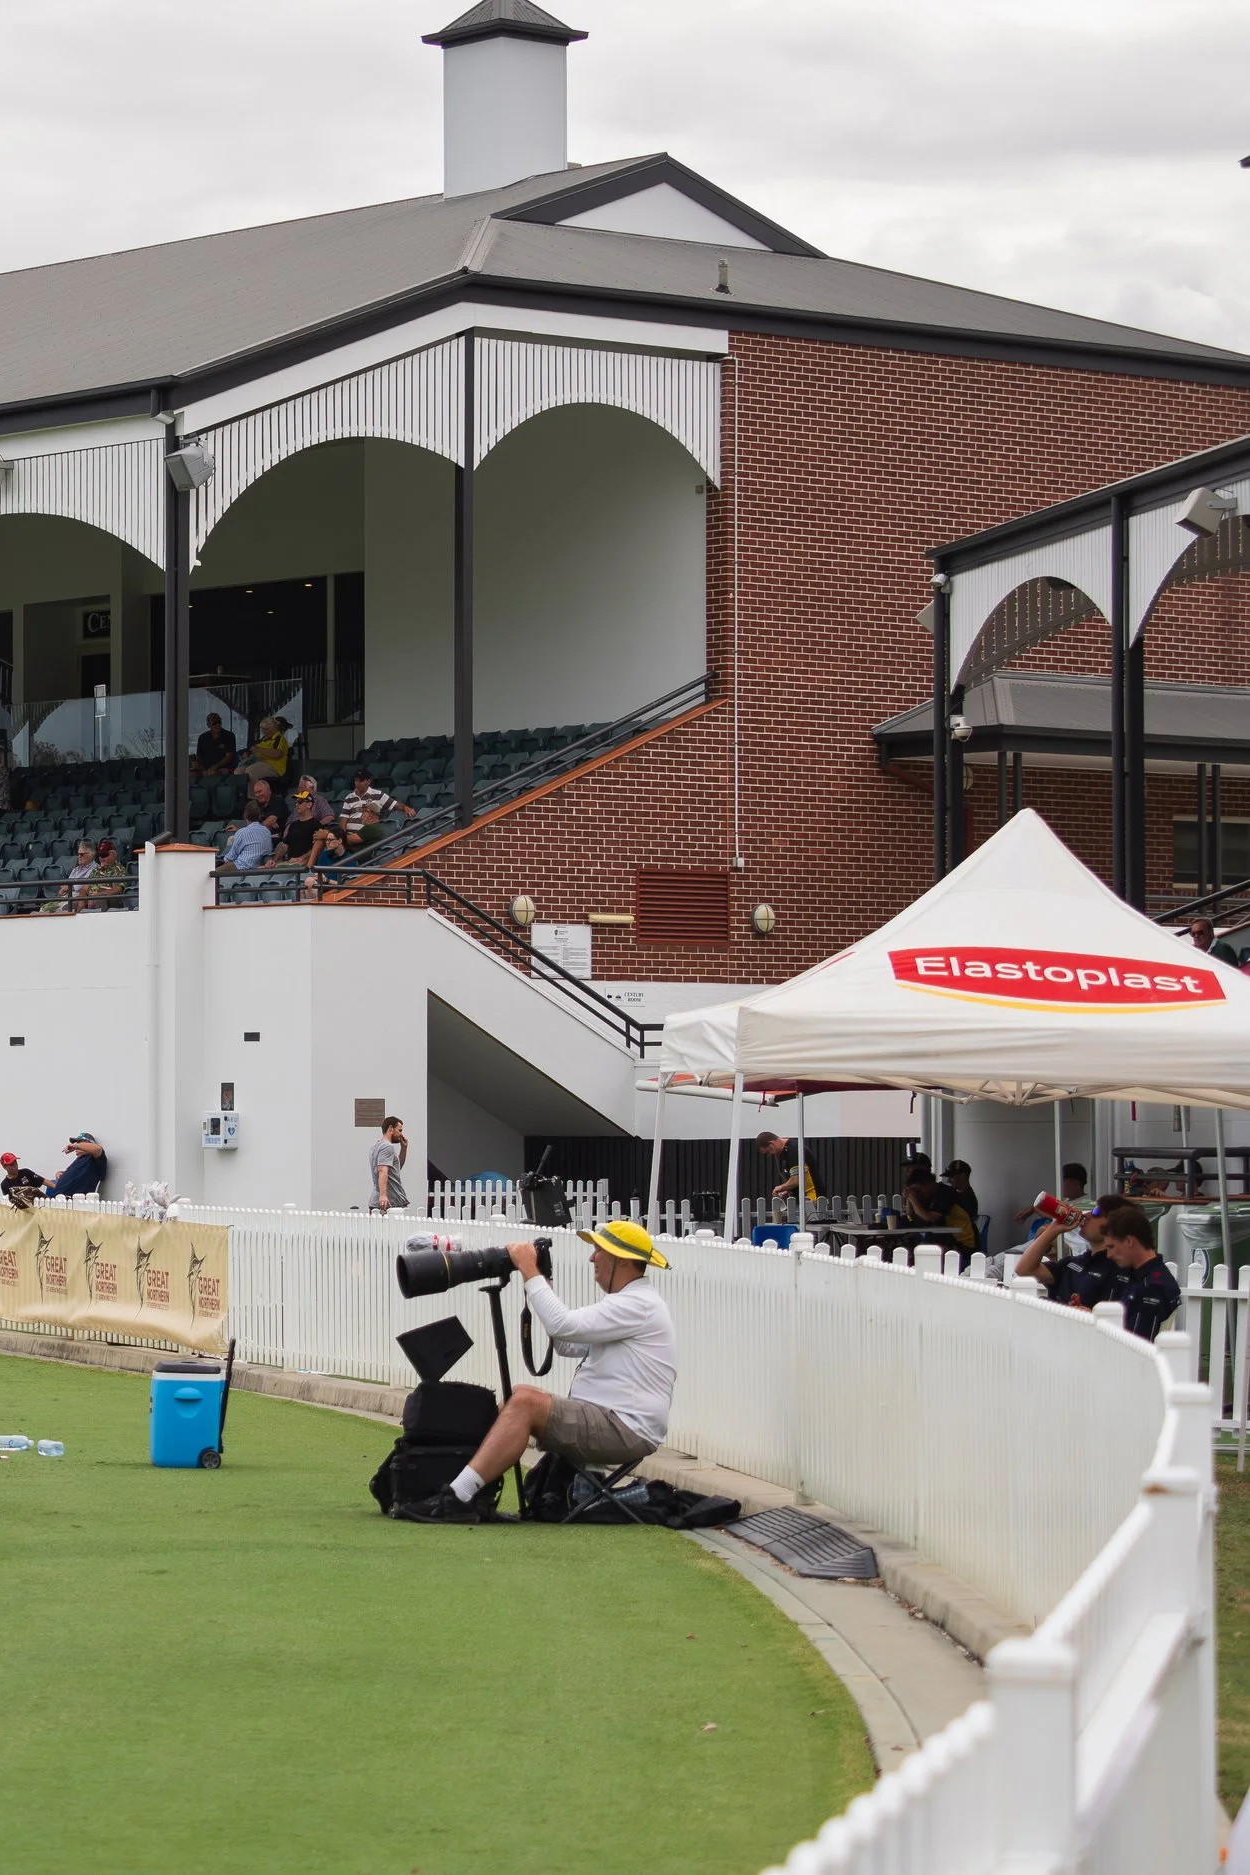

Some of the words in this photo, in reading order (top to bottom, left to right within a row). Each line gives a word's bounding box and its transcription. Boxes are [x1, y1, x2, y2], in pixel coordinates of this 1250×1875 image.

[915, 956, 1203, 993] Elastoplast
[45, 1255, 67, 1274] GREAT
[95, 1261, 117, 1281] GREAT
[45, 1273, 67, 1287] NORTHERN
[95, 1281, 117, 1295] NORTHERN
[146, 1269, 169, 1289] GREAT
[198, 1276, 220, 1296] GREAT
[146, 1288, 169, 1303] NORTHERN
[198, 1295, 220, 1311] NORTHERN
